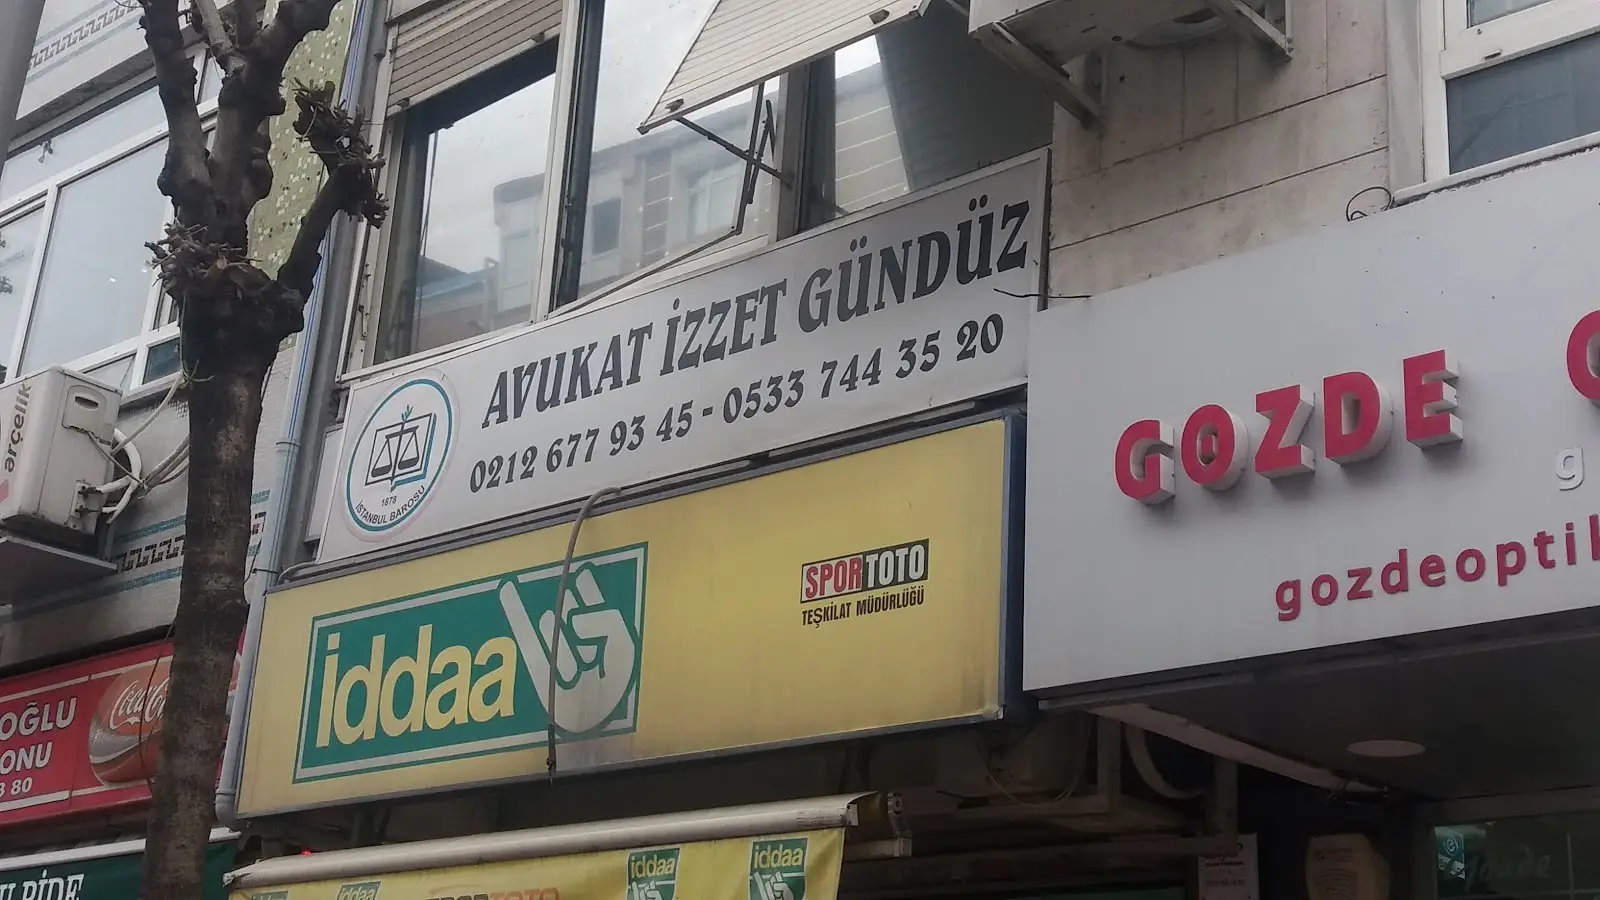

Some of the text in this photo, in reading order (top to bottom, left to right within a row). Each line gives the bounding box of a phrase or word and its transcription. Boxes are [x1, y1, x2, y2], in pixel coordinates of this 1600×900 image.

[481, 194, 1030, 429] AVUKAT İZZET GÜNDÜZ
[469, 446, 538, 493] 0212
[546, 428, 600, 472] 677
[609, 414, 646, 456] 93
[656, 400, 694, 442] 45
[722, 369, 805, 424] 0533
[820, 348, 882, 399] 744
[895, 330, 941, 379] 35
[956, 313, 1004, 362] 20
[1114, 349, 1464, 503] GOZDE
[381, 495, 397, 507] 1878
[389, 485, 425, 522] BAROSU
[802, 585, 925, 629] TEŞKİLAT MÜDÜRLÜĞÜ
[11, 777, 33, 796] 80
[631, 854, 676, 879] iddaa
[753, 843, 803, 869] iddaa
